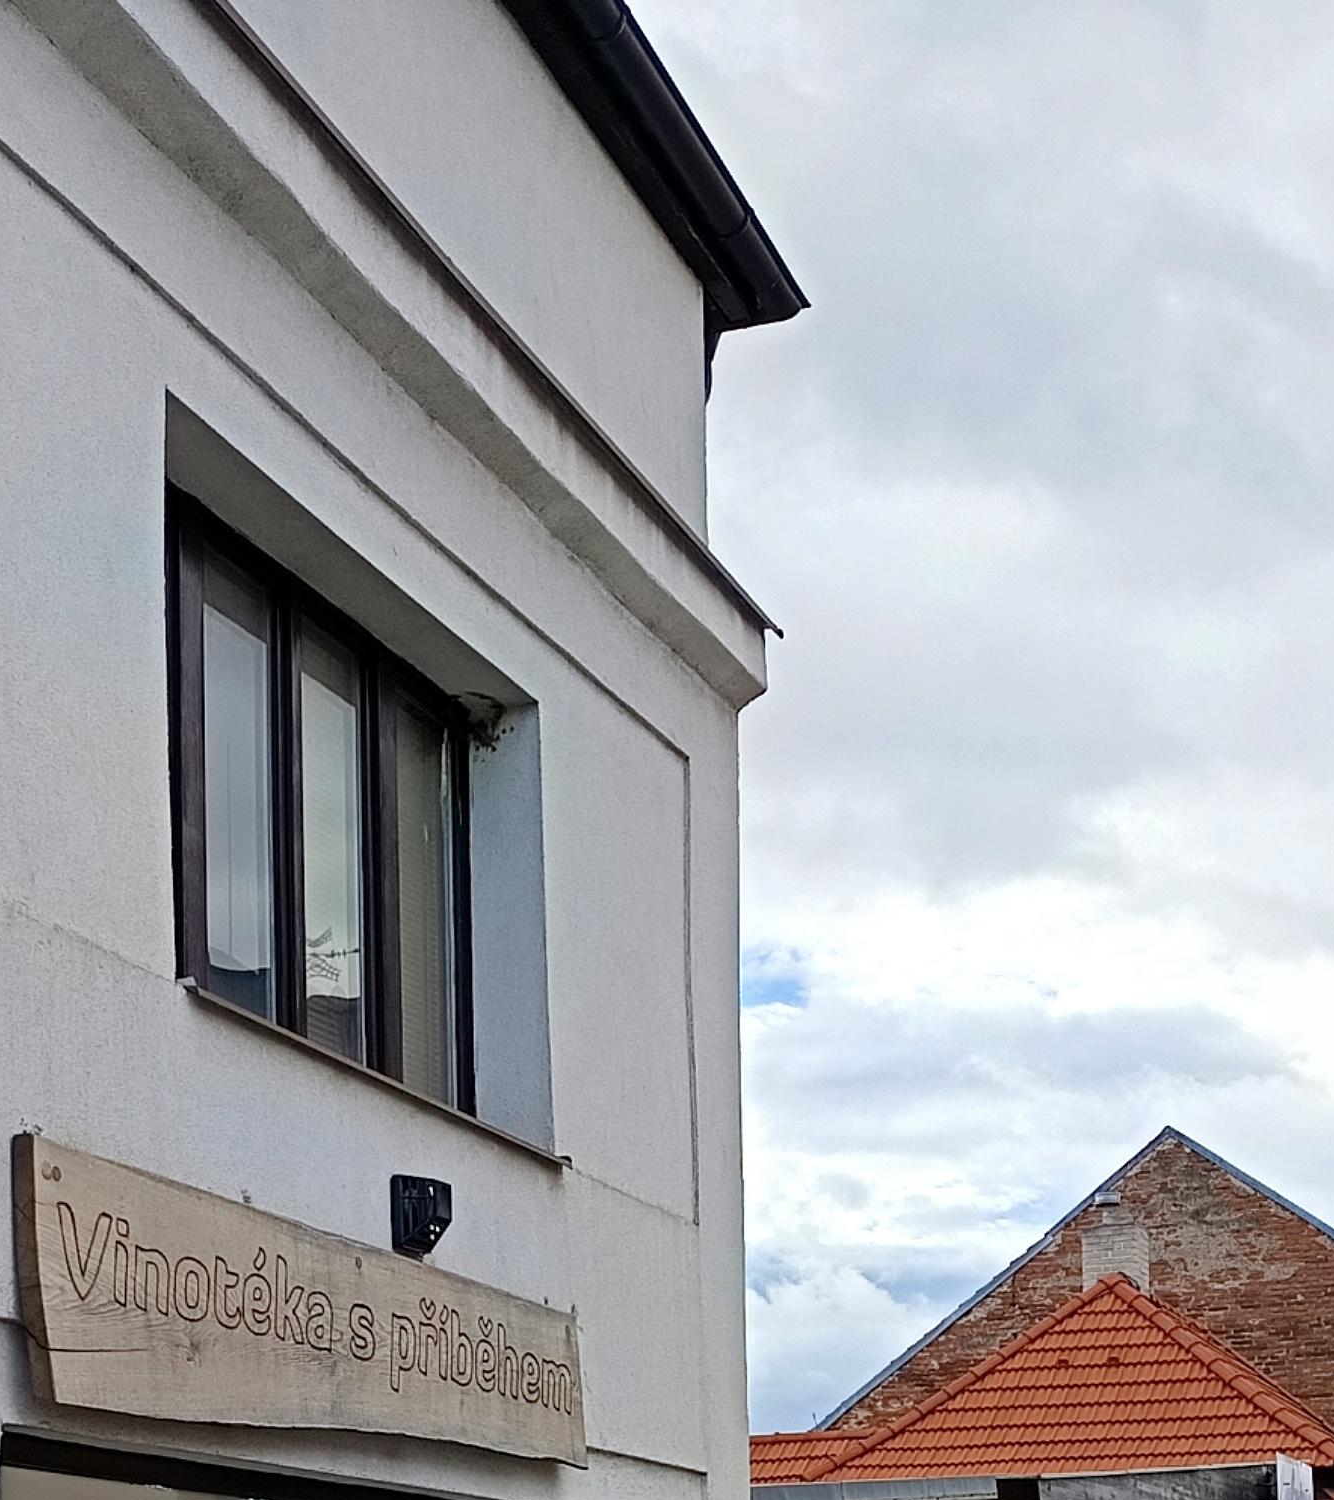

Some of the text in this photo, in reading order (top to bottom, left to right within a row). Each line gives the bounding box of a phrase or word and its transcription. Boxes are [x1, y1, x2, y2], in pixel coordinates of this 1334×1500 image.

[55, 1200, 575, 1416] Vinotéka s příběhem
